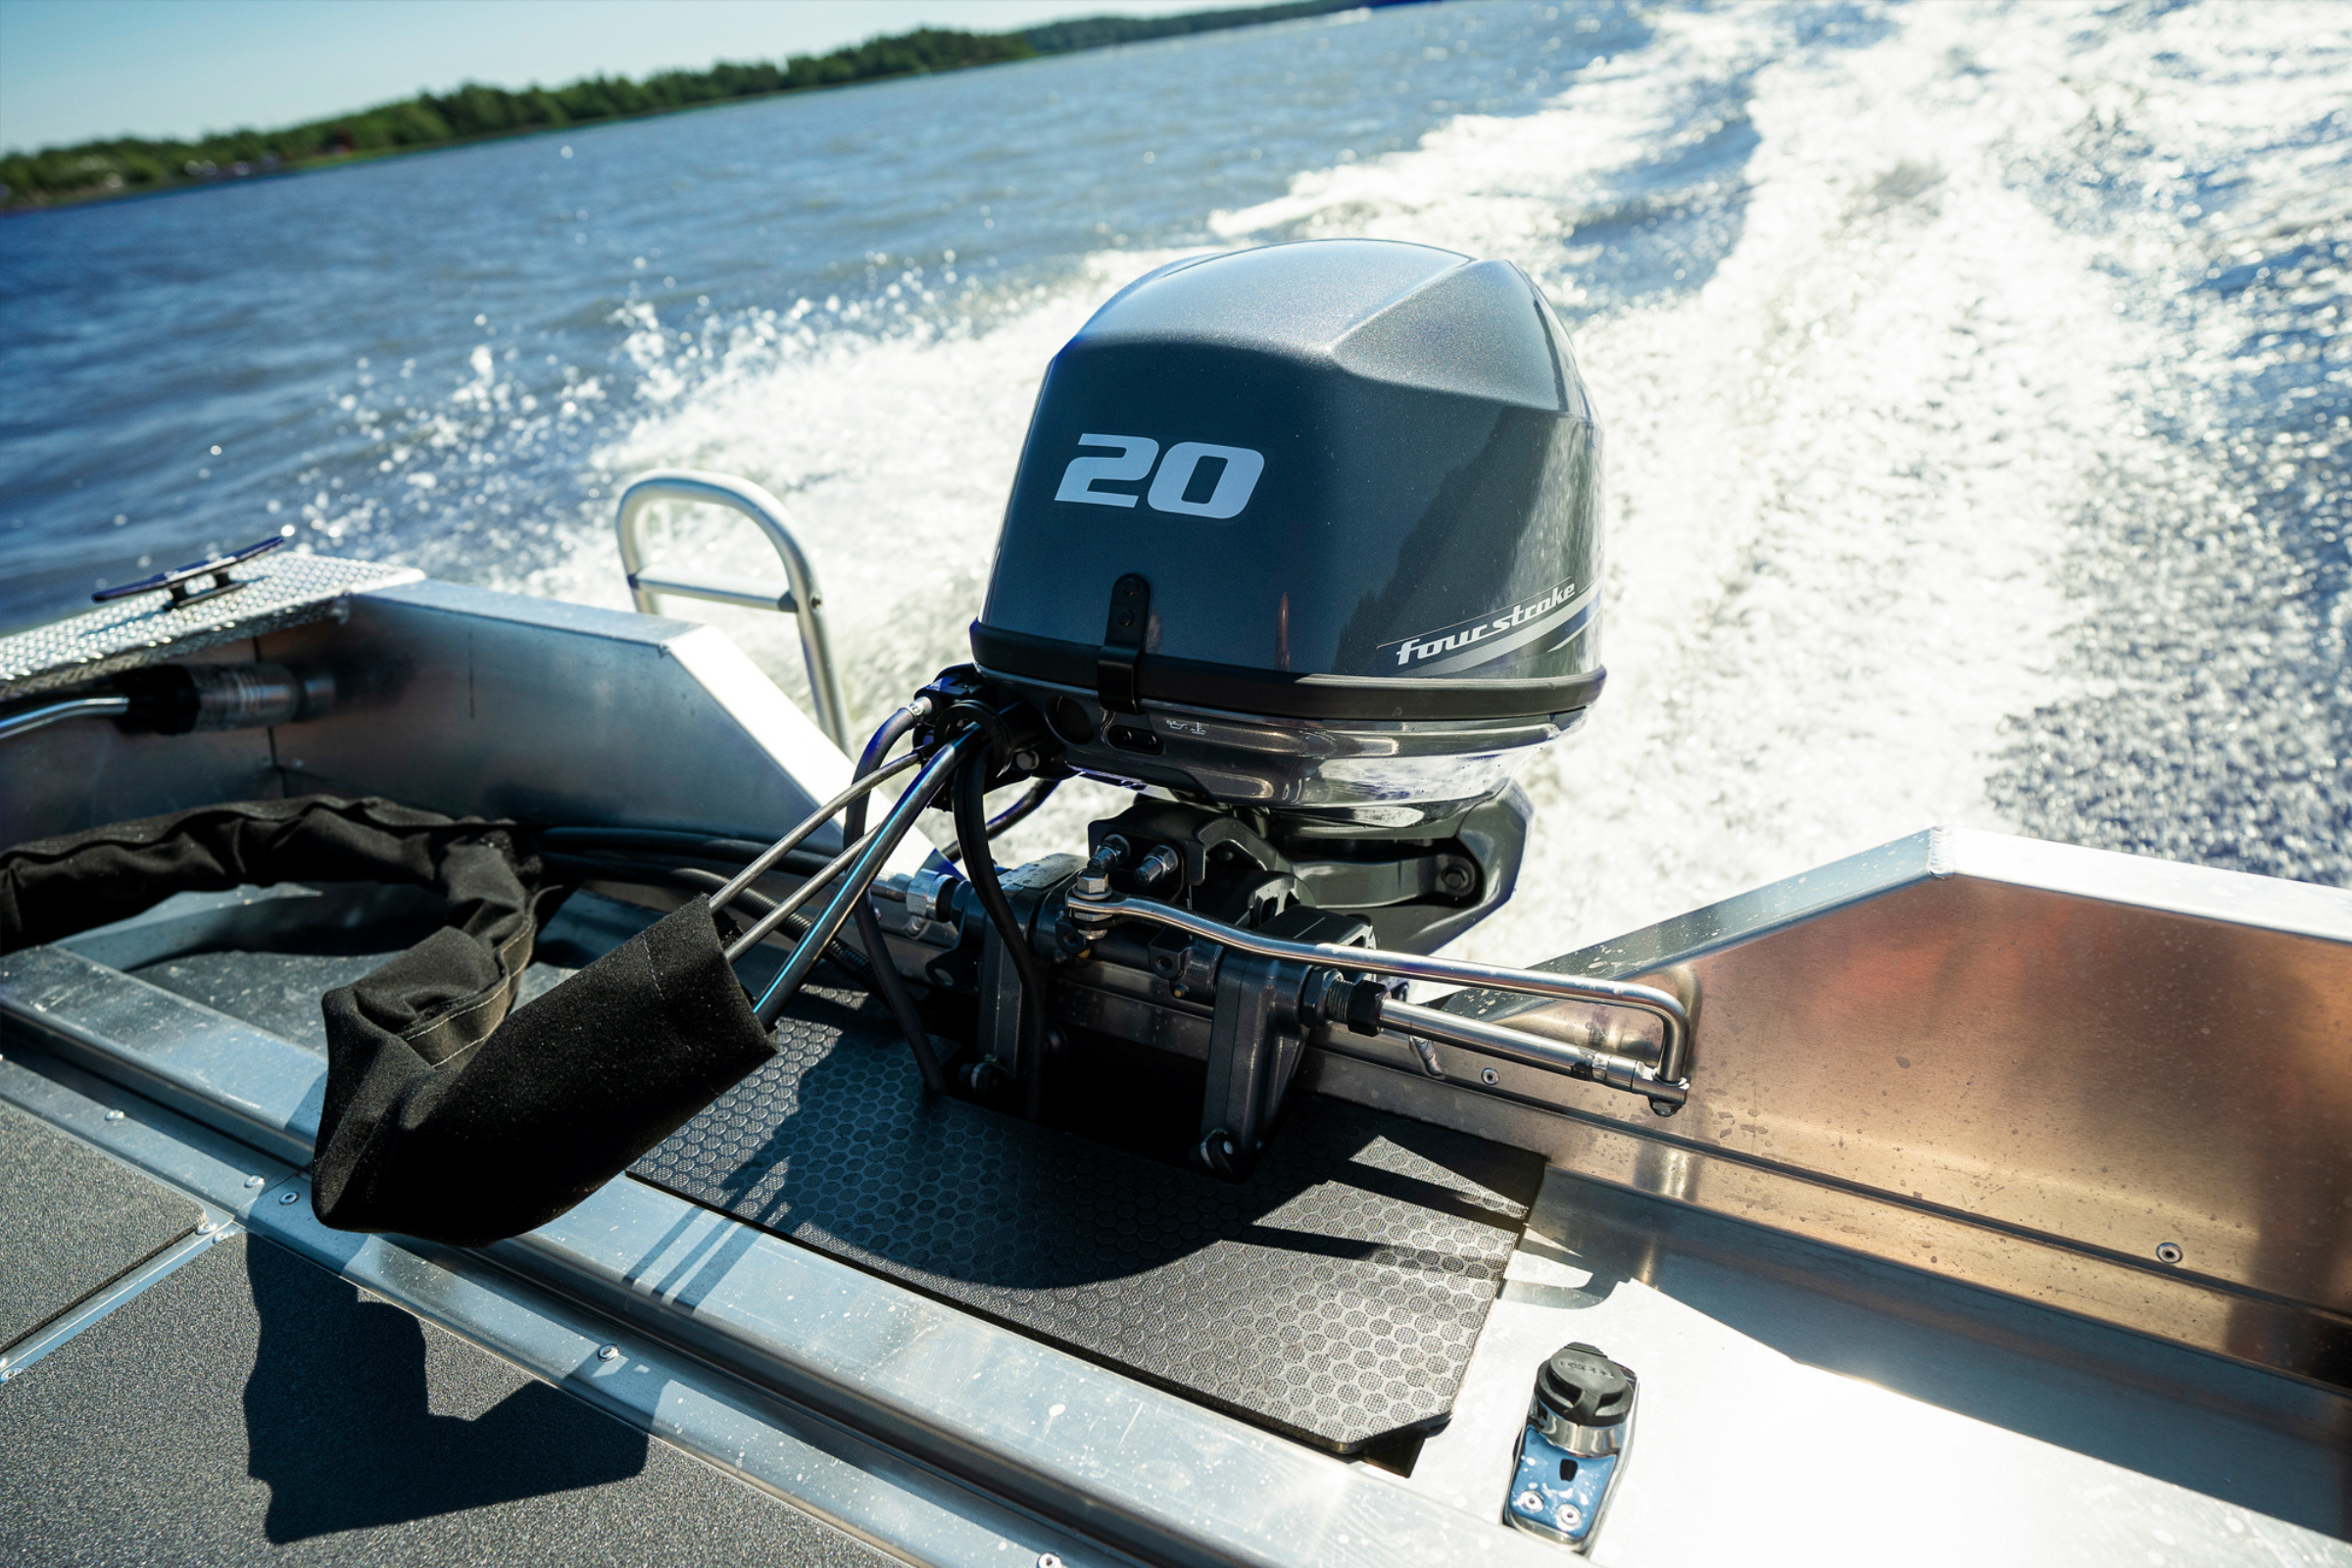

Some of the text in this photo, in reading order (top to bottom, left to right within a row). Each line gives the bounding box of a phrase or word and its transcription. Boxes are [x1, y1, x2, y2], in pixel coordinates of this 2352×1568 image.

[1054, 433, 1264, 518] 20
[1396, 583, 1575, 665] four stroke
